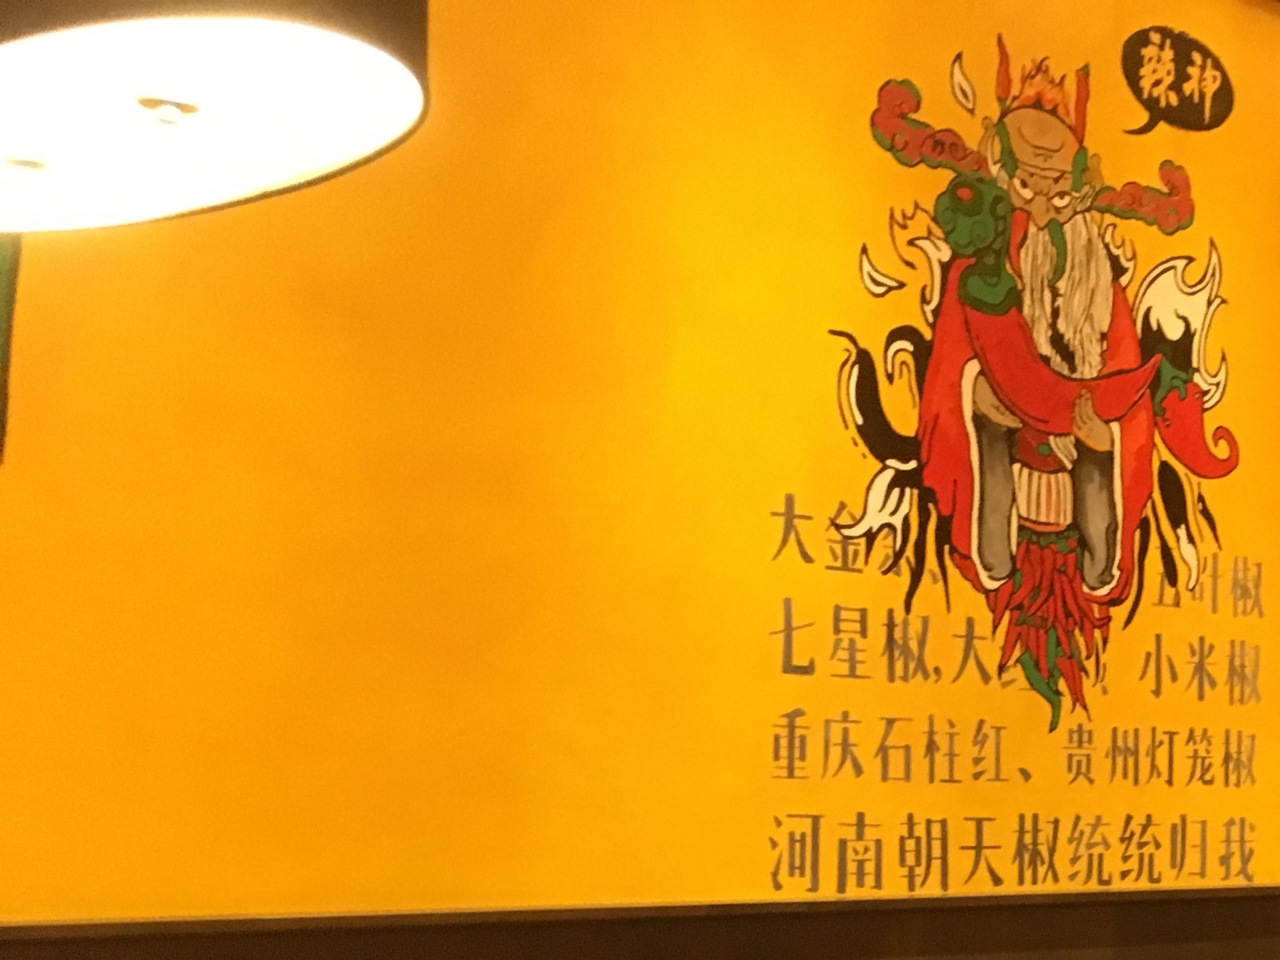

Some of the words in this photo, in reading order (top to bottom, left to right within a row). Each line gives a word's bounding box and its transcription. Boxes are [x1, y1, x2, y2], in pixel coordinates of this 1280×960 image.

[1139, 633, 1262, 706] 小米椒
[772, 707, 1257, 788] 重庆石柱红、贵州灯笼椒
[768, 811, 1255, 894] 河南朝天椒统统归我
